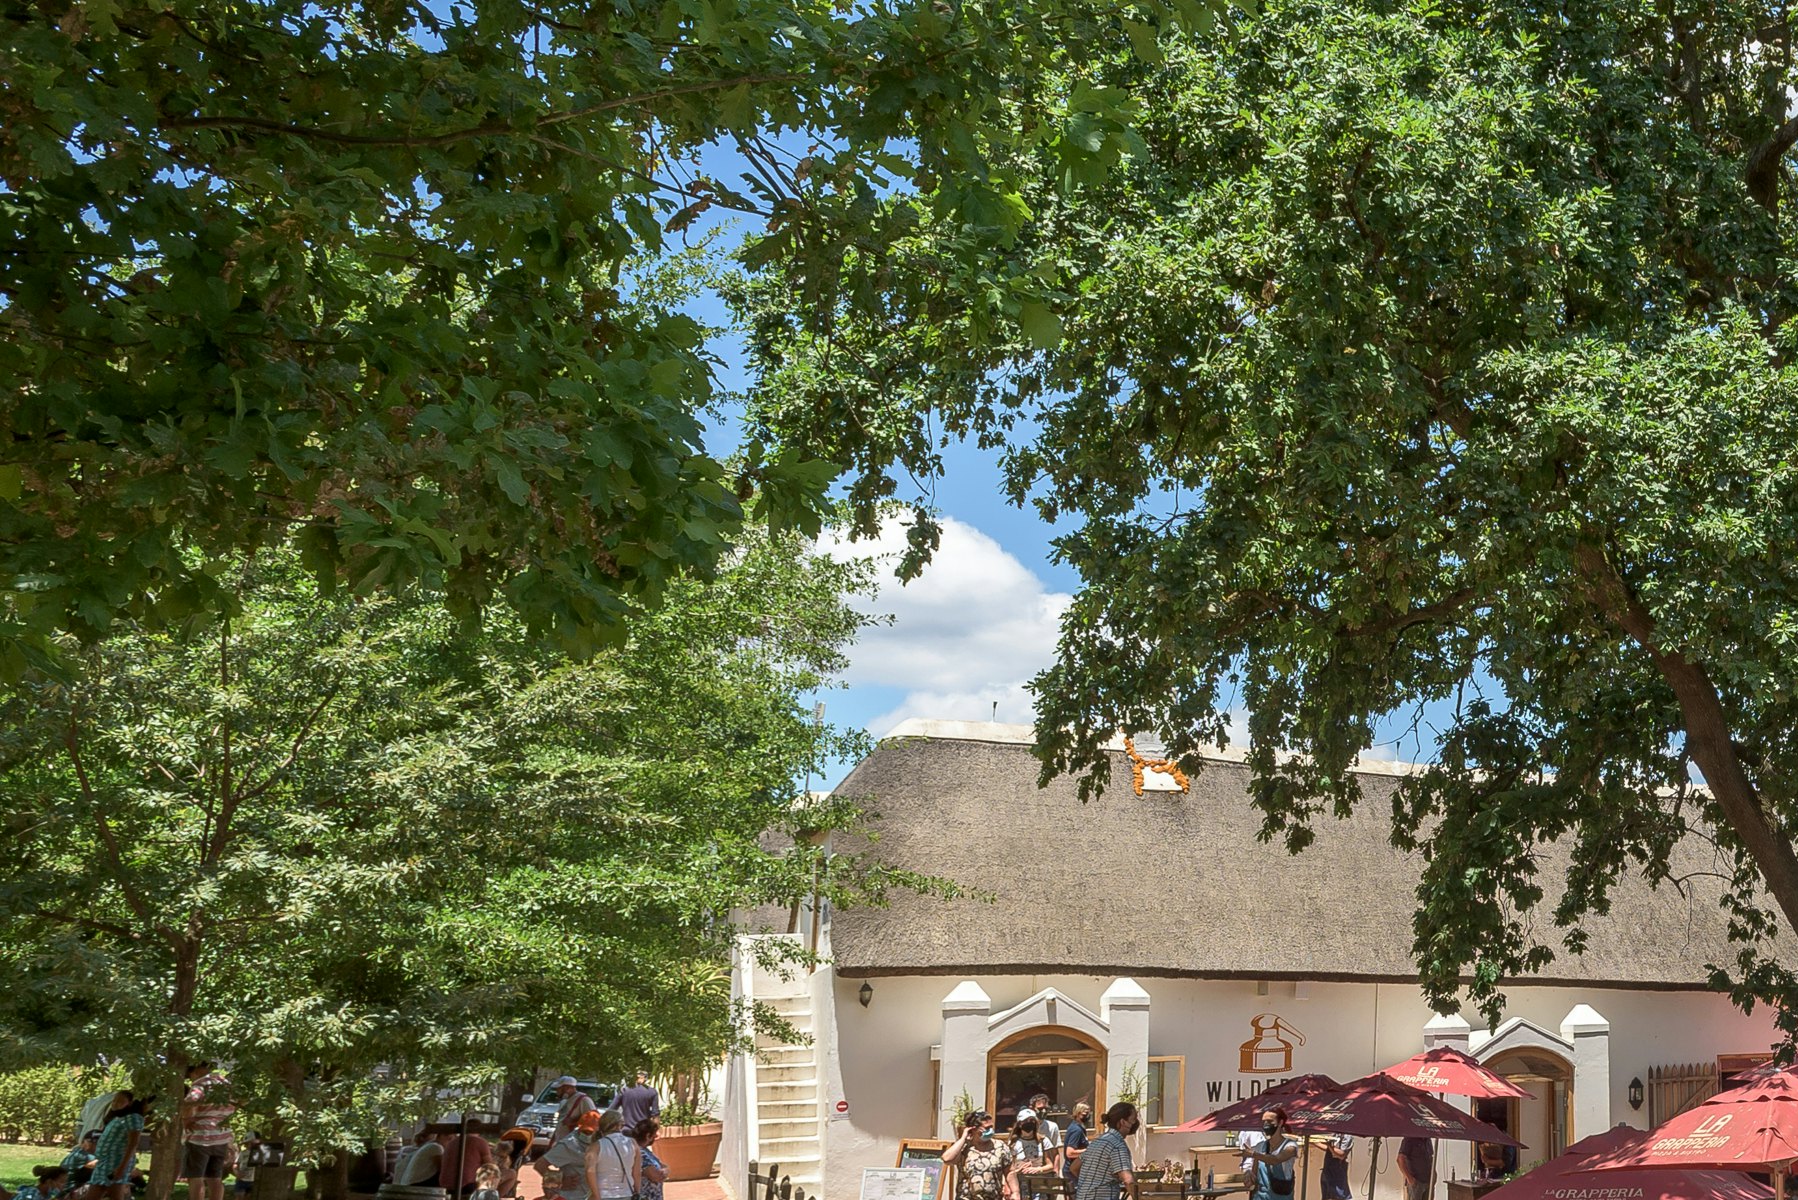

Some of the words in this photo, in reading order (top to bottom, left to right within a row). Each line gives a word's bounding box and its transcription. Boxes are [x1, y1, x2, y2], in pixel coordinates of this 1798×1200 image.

[1418, 1066, 1440, 1076] LA
[1396, 1075, 1450, 1086] GRAPPERIA
[1206, 1078, 1289, 1102] WILD
[1693, 1113, 1734, 1134] LA
[1651, 1135, 1731, 1150] GRAPPERIA
[1555, 1188, 1644, 1199] GRAPPERIA
